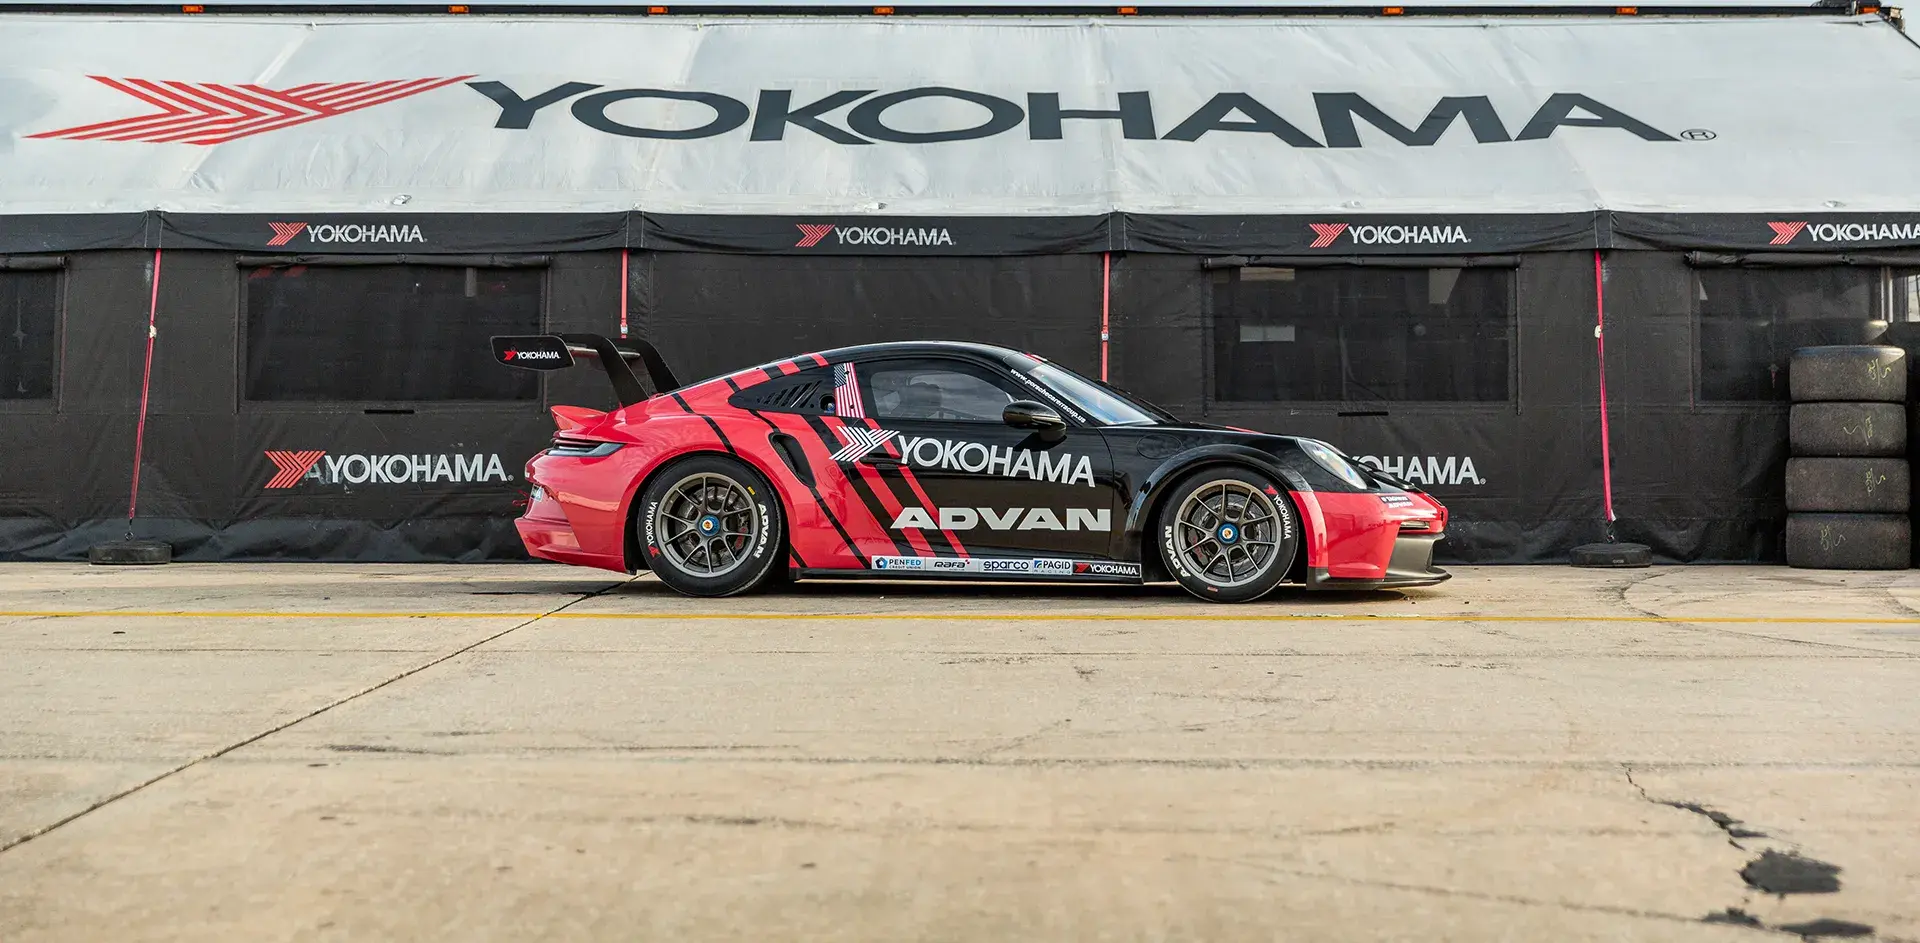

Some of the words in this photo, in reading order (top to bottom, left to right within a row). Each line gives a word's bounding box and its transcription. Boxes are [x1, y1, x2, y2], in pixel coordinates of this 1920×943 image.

[464, 81, 1680, 149] YOKOHAMA
[306, 224, 424, 243] YOKOHAMA
[834, 226, 953, 246] YOKOHAMA
[1348, 225, 1467, 244] YOKOHAMA
[516, 351, 560, 359] YOKOHAMA
[325, 454, 507, 483] YOKOHAMA
[898, 435, 1096, 488] YOKOHAMA
[646, 502, 658, 545] YOKOHAMA
[890, 507, 1111, 532] ADVAN
[1273, 494, 1292, 539] YOKOHAMA
[753, 504, 769, 558] ADVAN
[889, 558, 922, 566] PENFED
[1165, 526, 1191, 577] ADVAN
[983, 560, 1029, 571] sparco
[1043, 560, 1071, 569] PAGID
[1090, 564, 1137, 575] YOKOHAMA
